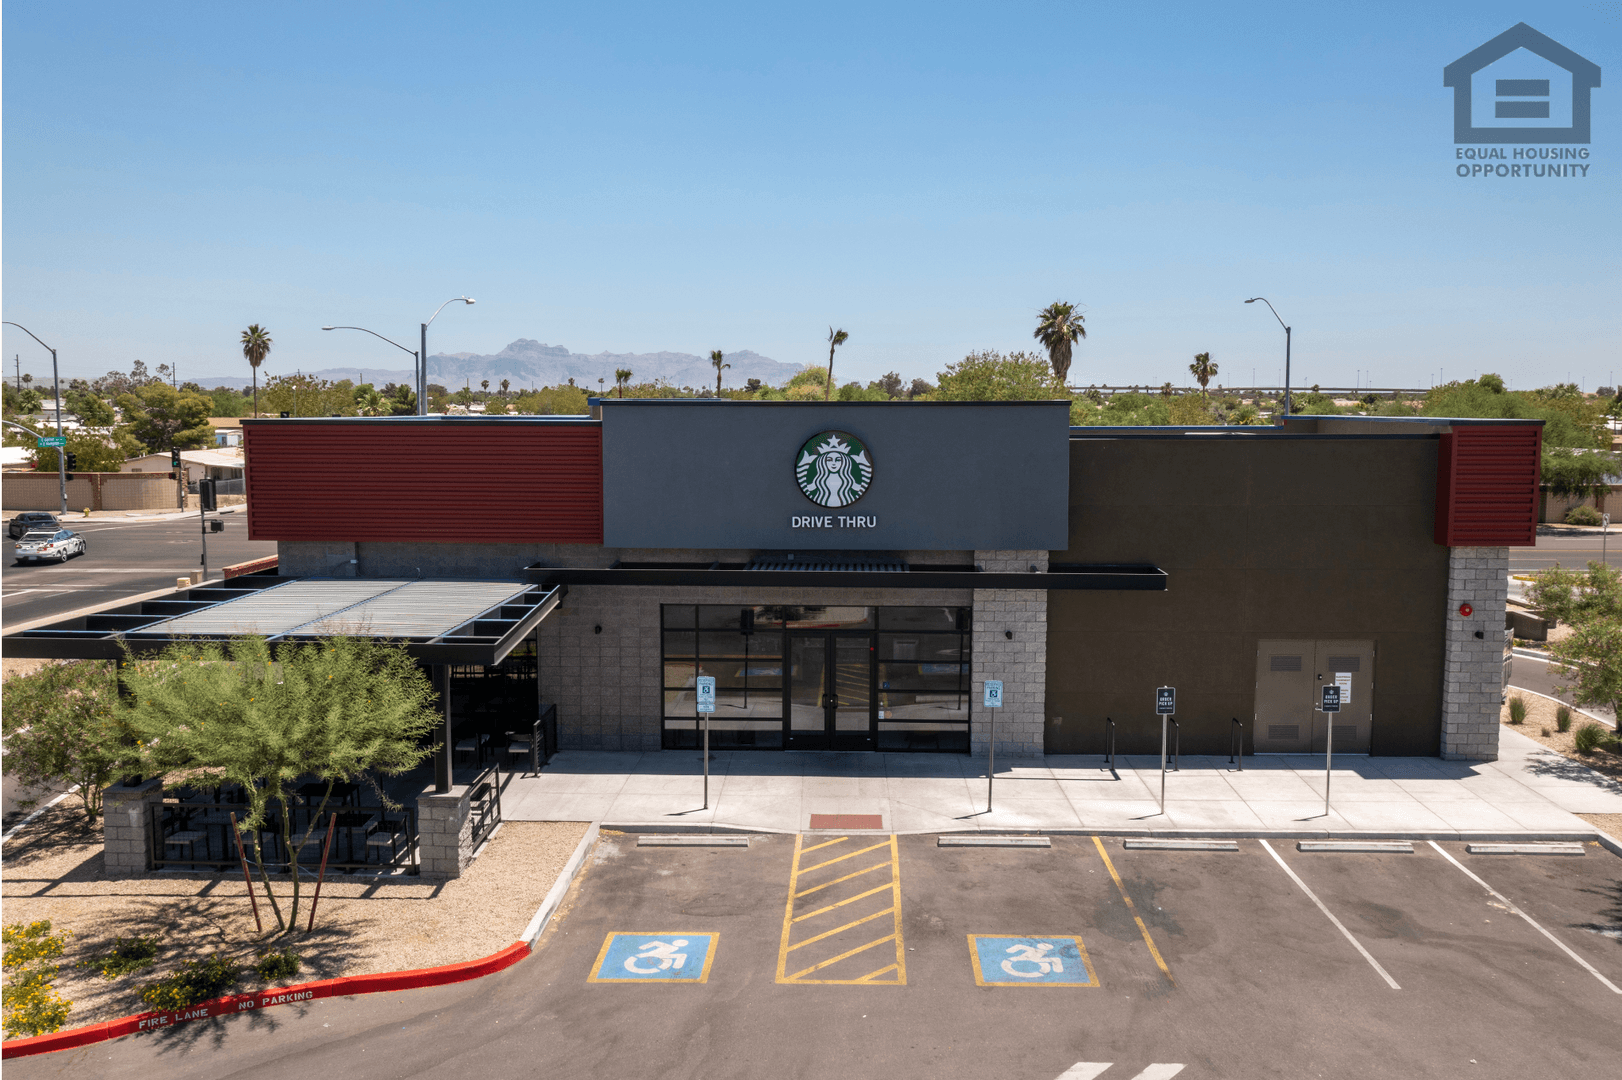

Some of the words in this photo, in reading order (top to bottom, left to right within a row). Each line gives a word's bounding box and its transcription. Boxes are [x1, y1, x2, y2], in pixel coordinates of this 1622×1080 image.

[791, 515, 833, 528] DRIVE
[837, 515, 877, 528] THRU
[238, 1000, 255, 1010] NO
[262, 991, 314, 1006] PARKING
[138, 1015, 168, 1029] FIRE
[175, 1008, 209, 1022] LANE
